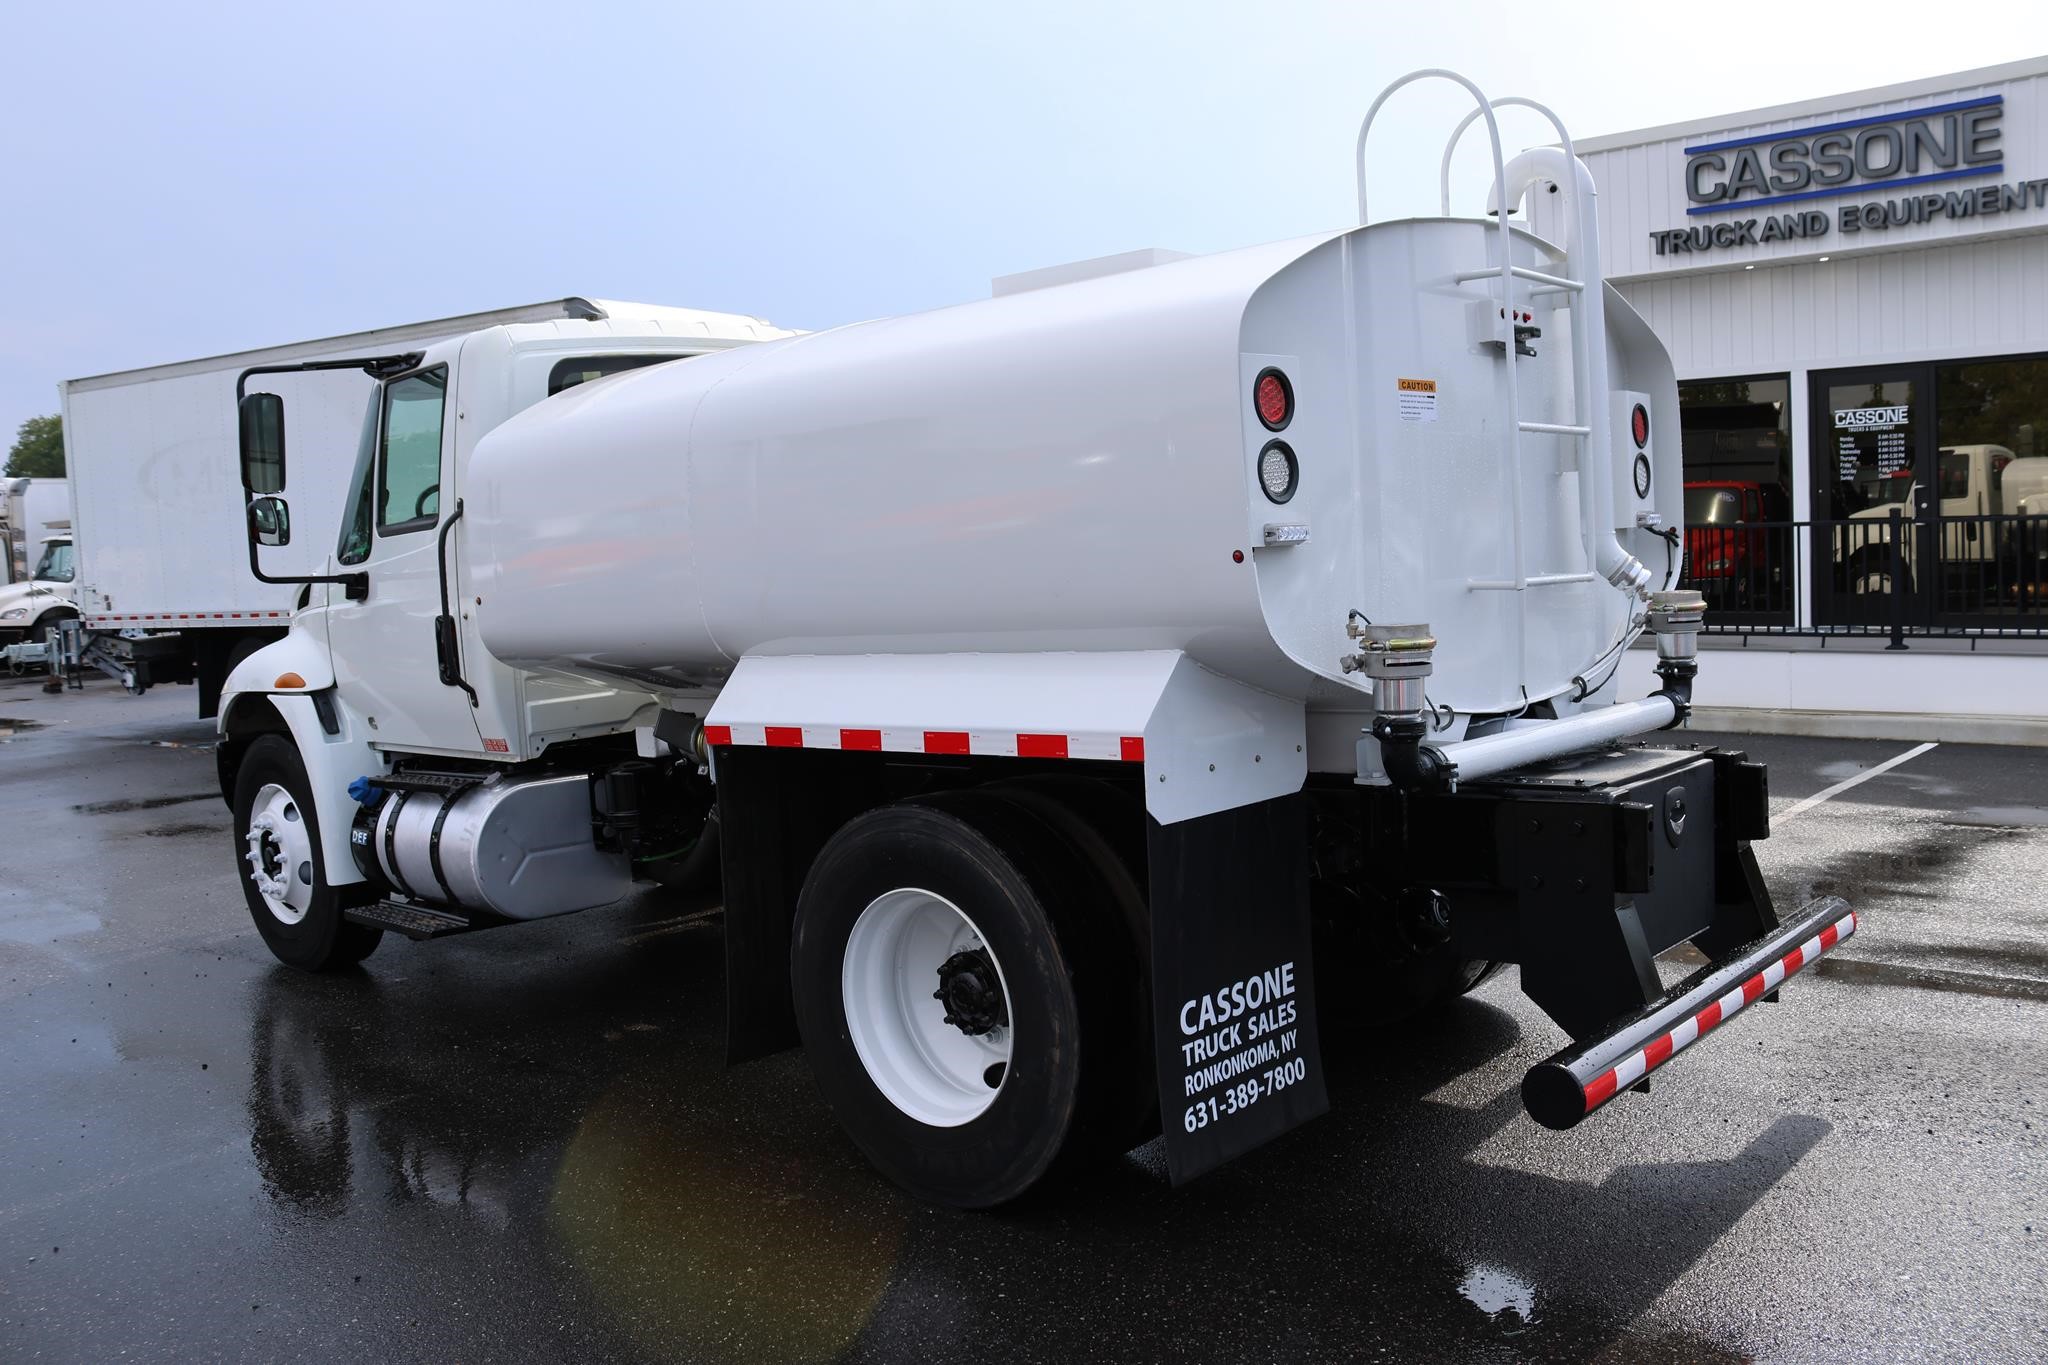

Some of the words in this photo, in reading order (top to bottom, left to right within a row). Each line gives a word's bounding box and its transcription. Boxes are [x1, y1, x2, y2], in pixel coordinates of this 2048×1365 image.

[1686, 107, 2004, 203] CASSONE
[1650, 218, 1758, 256] TRUCK
[1760, 210, 1829, 243] AND
[1838, 178, 2048, 233] EQUIPMENT
[1401, 381, 1434, 391] CAUTION
[1835, 408, 1909, 425] CASSONE
[352, 830, 368, 844] DEF
[1180, 962, 1295, 1036] CASSONE
[1182, 1023, 1242, 1067] TRUCK
[1248, 1000, 1297, 1040] SALES
[1184, 1039, 1280, 1097] RONKONKOMA,
[1281, 1029, 1297, 1054] NY
[1184, 1057, 1306, 1133] 631-389-7800
